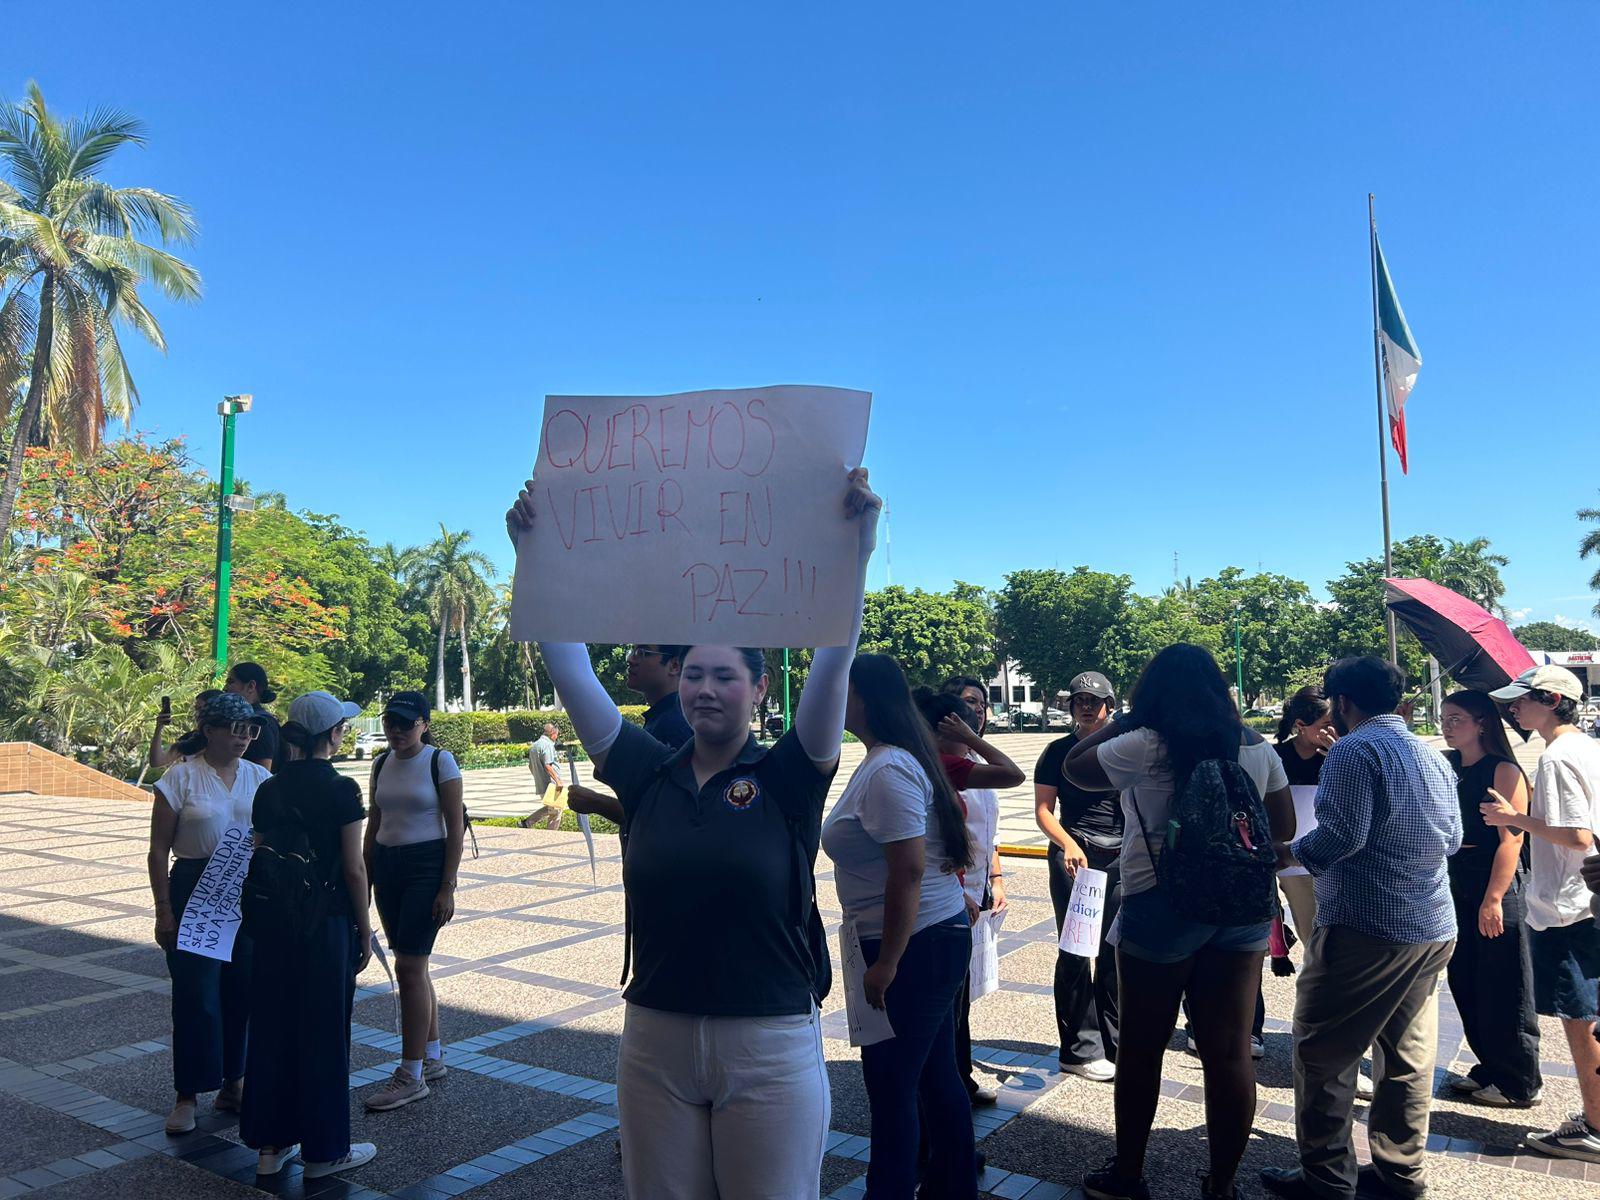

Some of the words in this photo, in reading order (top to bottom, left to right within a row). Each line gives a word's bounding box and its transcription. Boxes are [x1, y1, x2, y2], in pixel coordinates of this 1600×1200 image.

[545, 399, 775, 477] QUEREMOS
[547, 478, 693, 550] VIVIR
[719, 486, 772, 547] EN
[682, 557, 816, 624] PAZ!!!
[184, 828, 242, 919] UNIVERSIDAD
[192, 935, 203, 949] SE
[200, 909, 212, 919] A
[207, 852, 246, 907] CONSTRUIR
[215, 870, 247, 916] PERDER
[179, 939, 191, 948] A
[180, 923, 193, 938] LA
[205, 930, 220, 950] NO
[211, 919, 225, 929] A
